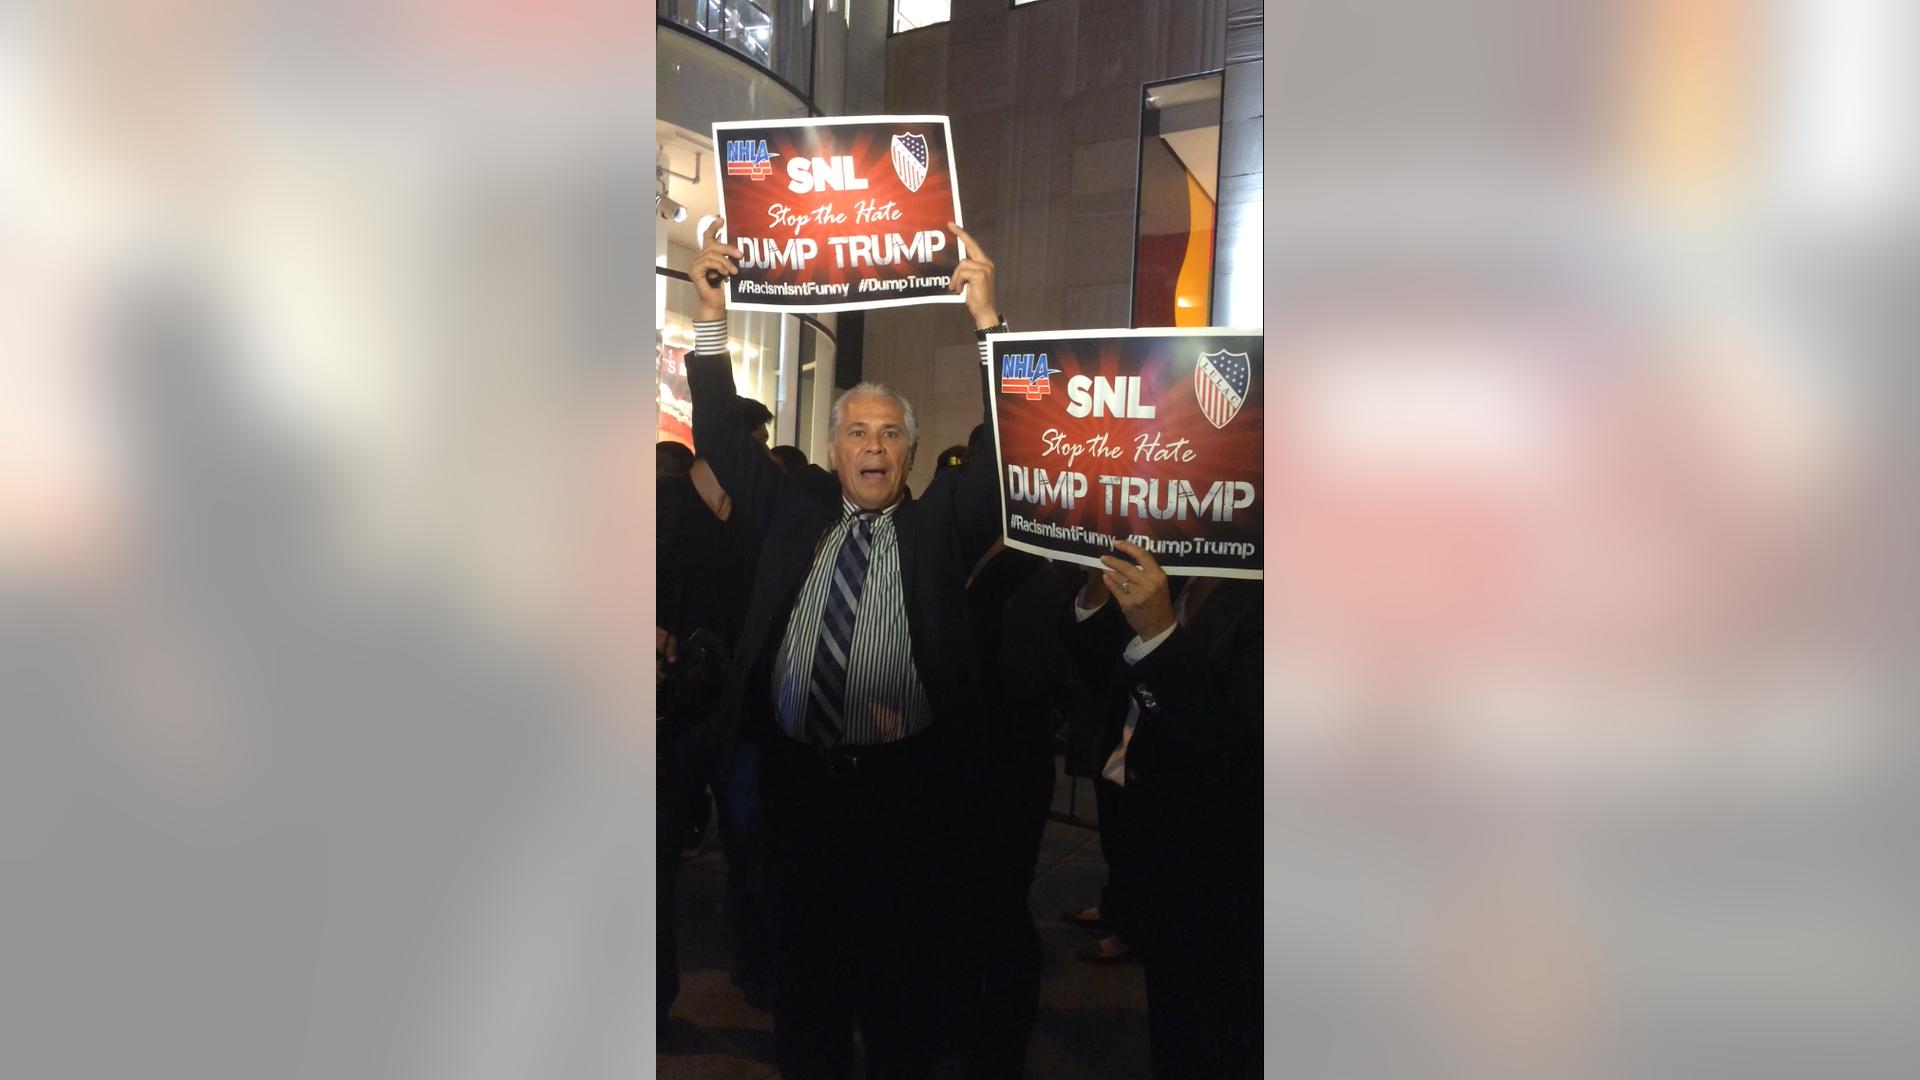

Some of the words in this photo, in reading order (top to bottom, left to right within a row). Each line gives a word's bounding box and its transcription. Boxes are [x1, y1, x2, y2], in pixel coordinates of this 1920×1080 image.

[727, 139, 774, 165] NHLA
[786, 156, 868, 194] SNL
[767, 203, 811, 235] Stop
[808, 203, 847, 225] the
[854, 199, 902, 225] Hate
[737, 236, 818, 270] DUMP
[828, 230, 946, 269] TRUMP
[738, 279, 850, 297] #RacismIsntFunny
[858, 275, 951, 293] #DumpTrump
[1002, 353, 1058, 383] NHLA
[1201, 361, 1239, 405] LULAC
[1066, 375, 1156, 419] SNL
[1041, 428, 1086, 467] Stop
[1085, 432, 1123, 460] the
[1133, 432, 1197, 463] Hate
[1008, 464, 1088, 511] DUMP
[1099, 475, 1256, 522] TRUMP
[1010, 514, 1117, 552] #RacismIsntFunny
[1126, 533, 1256, 560] #DumpTrump
